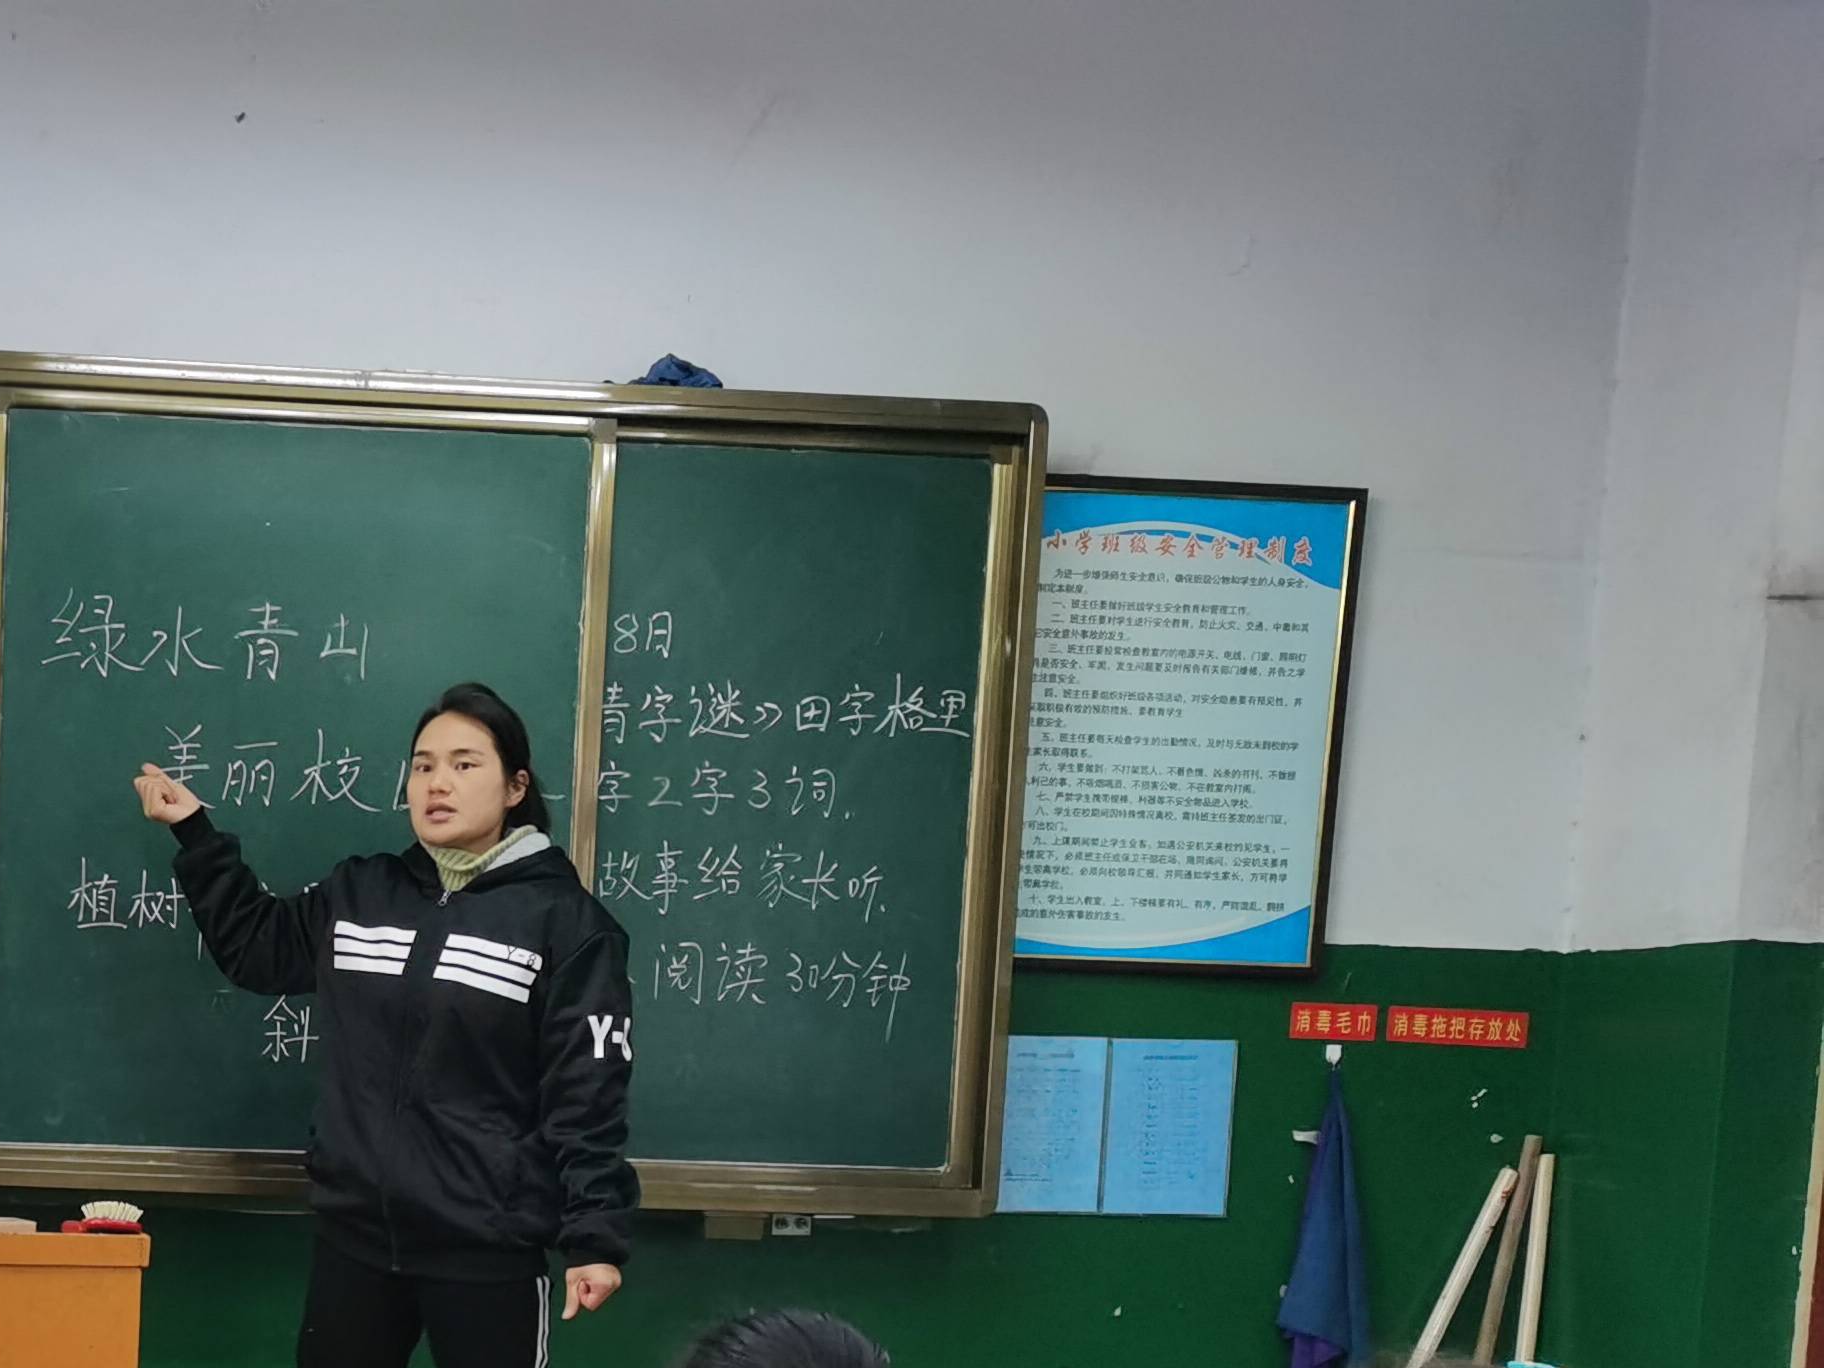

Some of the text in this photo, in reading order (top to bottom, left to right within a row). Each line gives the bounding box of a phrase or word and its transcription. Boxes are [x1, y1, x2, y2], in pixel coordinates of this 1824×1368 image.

[1047, 530, 1313, 567] 小学班级安全管理制度
[42, 588, 369, 681] 绿水青山
[1295, 1009, 1372, 1037] 消毒毛巾
[1393, 1013, 1522, 1043] 消毒拖把存放处
